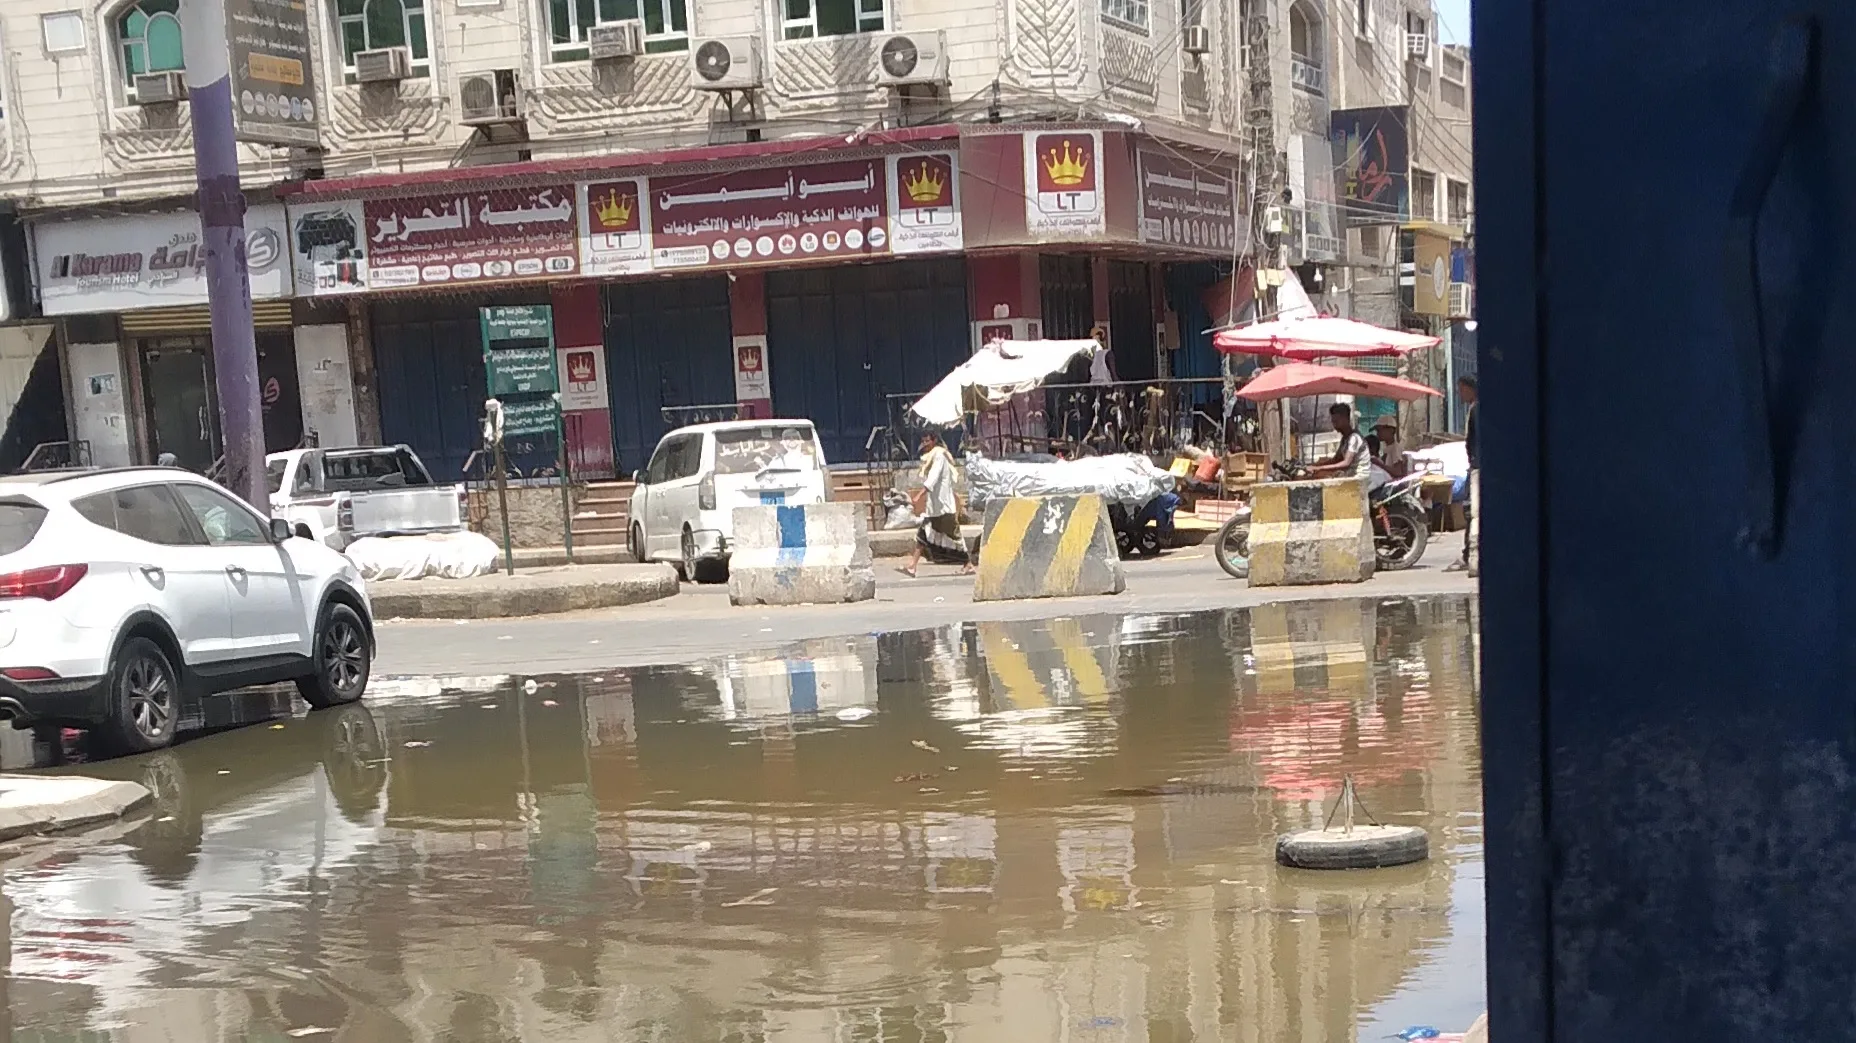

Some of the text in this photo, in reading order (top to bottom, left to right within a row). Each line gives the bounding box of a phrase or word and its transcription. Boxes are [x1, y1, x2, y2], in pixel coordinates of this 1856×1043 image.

[659, 162, 875, 211] أبو أيمن
[1056, 192, 1081, 210] LT
[371, 189, 572, 243] مكتبة التحرير
[801, 207, 835, 225] الذكية
[838, 203, 879, 222] للهواتف
[915, 207, 938, 224] LT
[169, 232, 197, 248] فندق
[605, 232, 627, 248] LT
[50, 255, 70, 278] Al
[112, 272, 139, 284] Hotel
